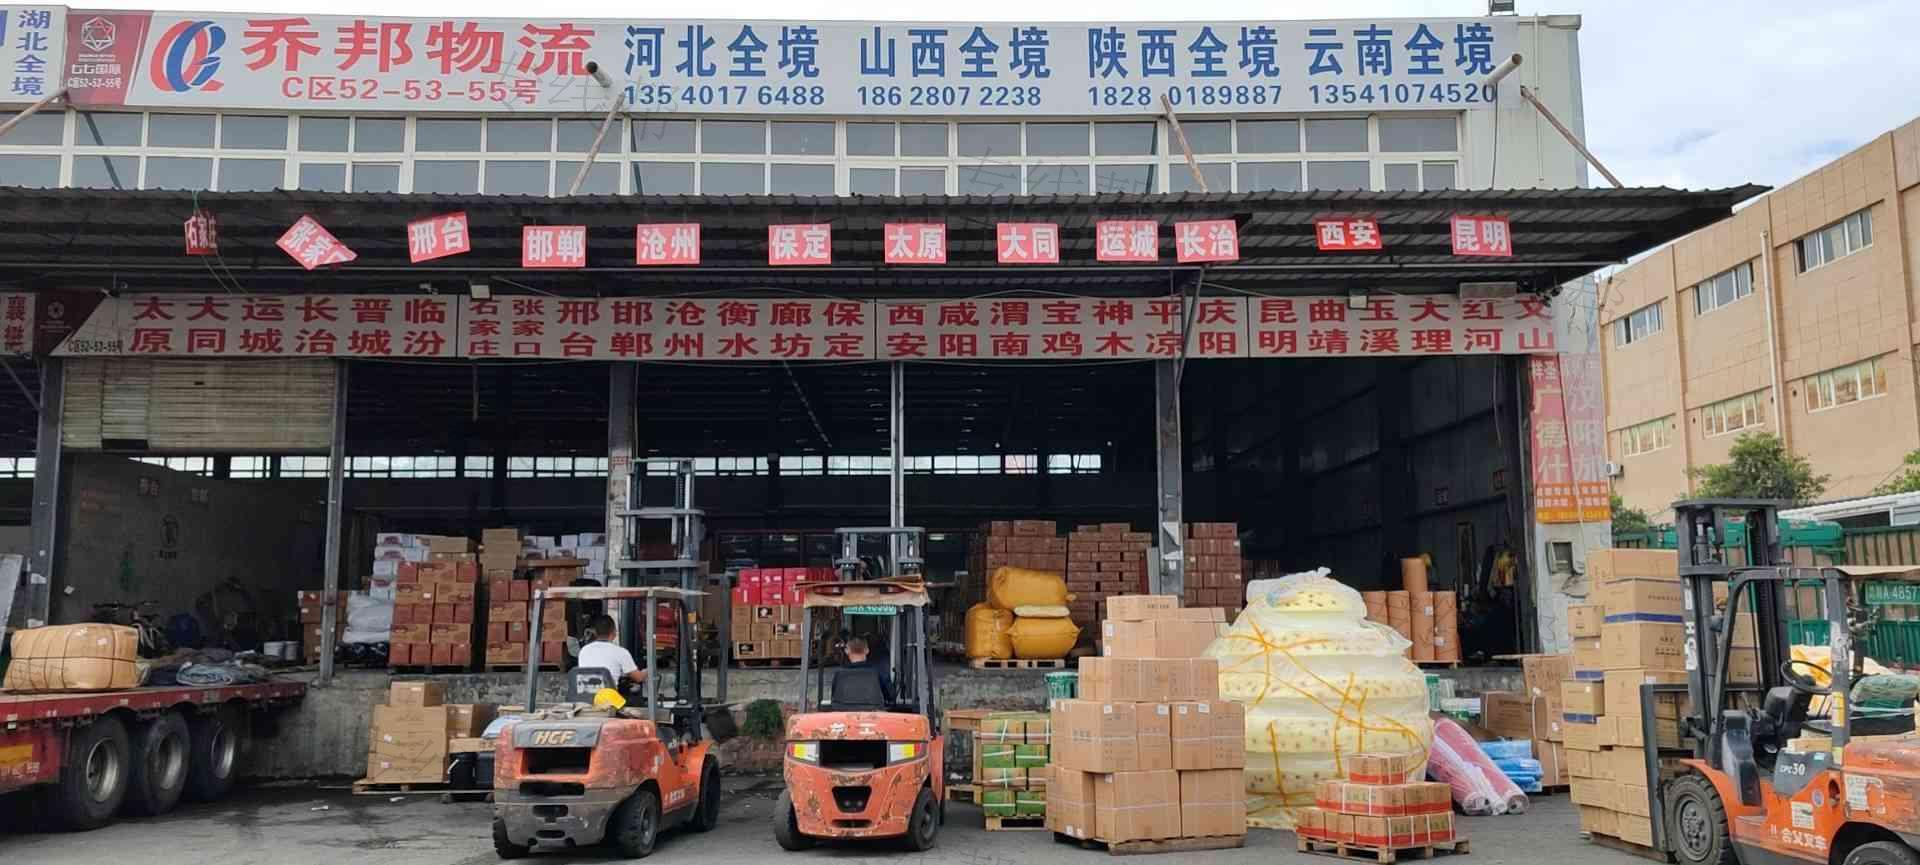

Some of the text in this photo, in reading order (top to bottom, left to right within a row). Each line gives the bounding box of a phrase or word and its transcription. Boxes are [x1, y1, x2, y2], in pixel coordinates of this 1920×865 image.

[12, 10, 51, 95] 湖北全境
[241, 18, 595, 75] 乔邦物流
[624, 25, 820, 79] 河北全境
[860, 27, 1051, 79] 山西全境
[1088, 26, 1280, 79] 陕西全境
[1304, 22, 1496, 77] 云南全境
[282, 76, 541, 104] C区52-53-55号
[681, 86, 748, 105] 4017
[757, 86, 825, 106] 6488
[980, 86, 1041, 106] 2238
[1308, 83, 1496, 105] 13541074520
[411, 218, 465, 255] 邢台
[527, 229, 584, 263] 邯郸
[641, 229, 699, 261] 沧州
[771, 228, 829, 260] 保定
[887, 228, 946, 261] 太原
[1000, 226, 1058, 260] 大同
[1099, 224, 1157, 257] 运城
[1177, 224, 1236, 258] 长治
[1317, 219, 1378, 247] 西安
[1453, 217, 1508, 253] 昆明
